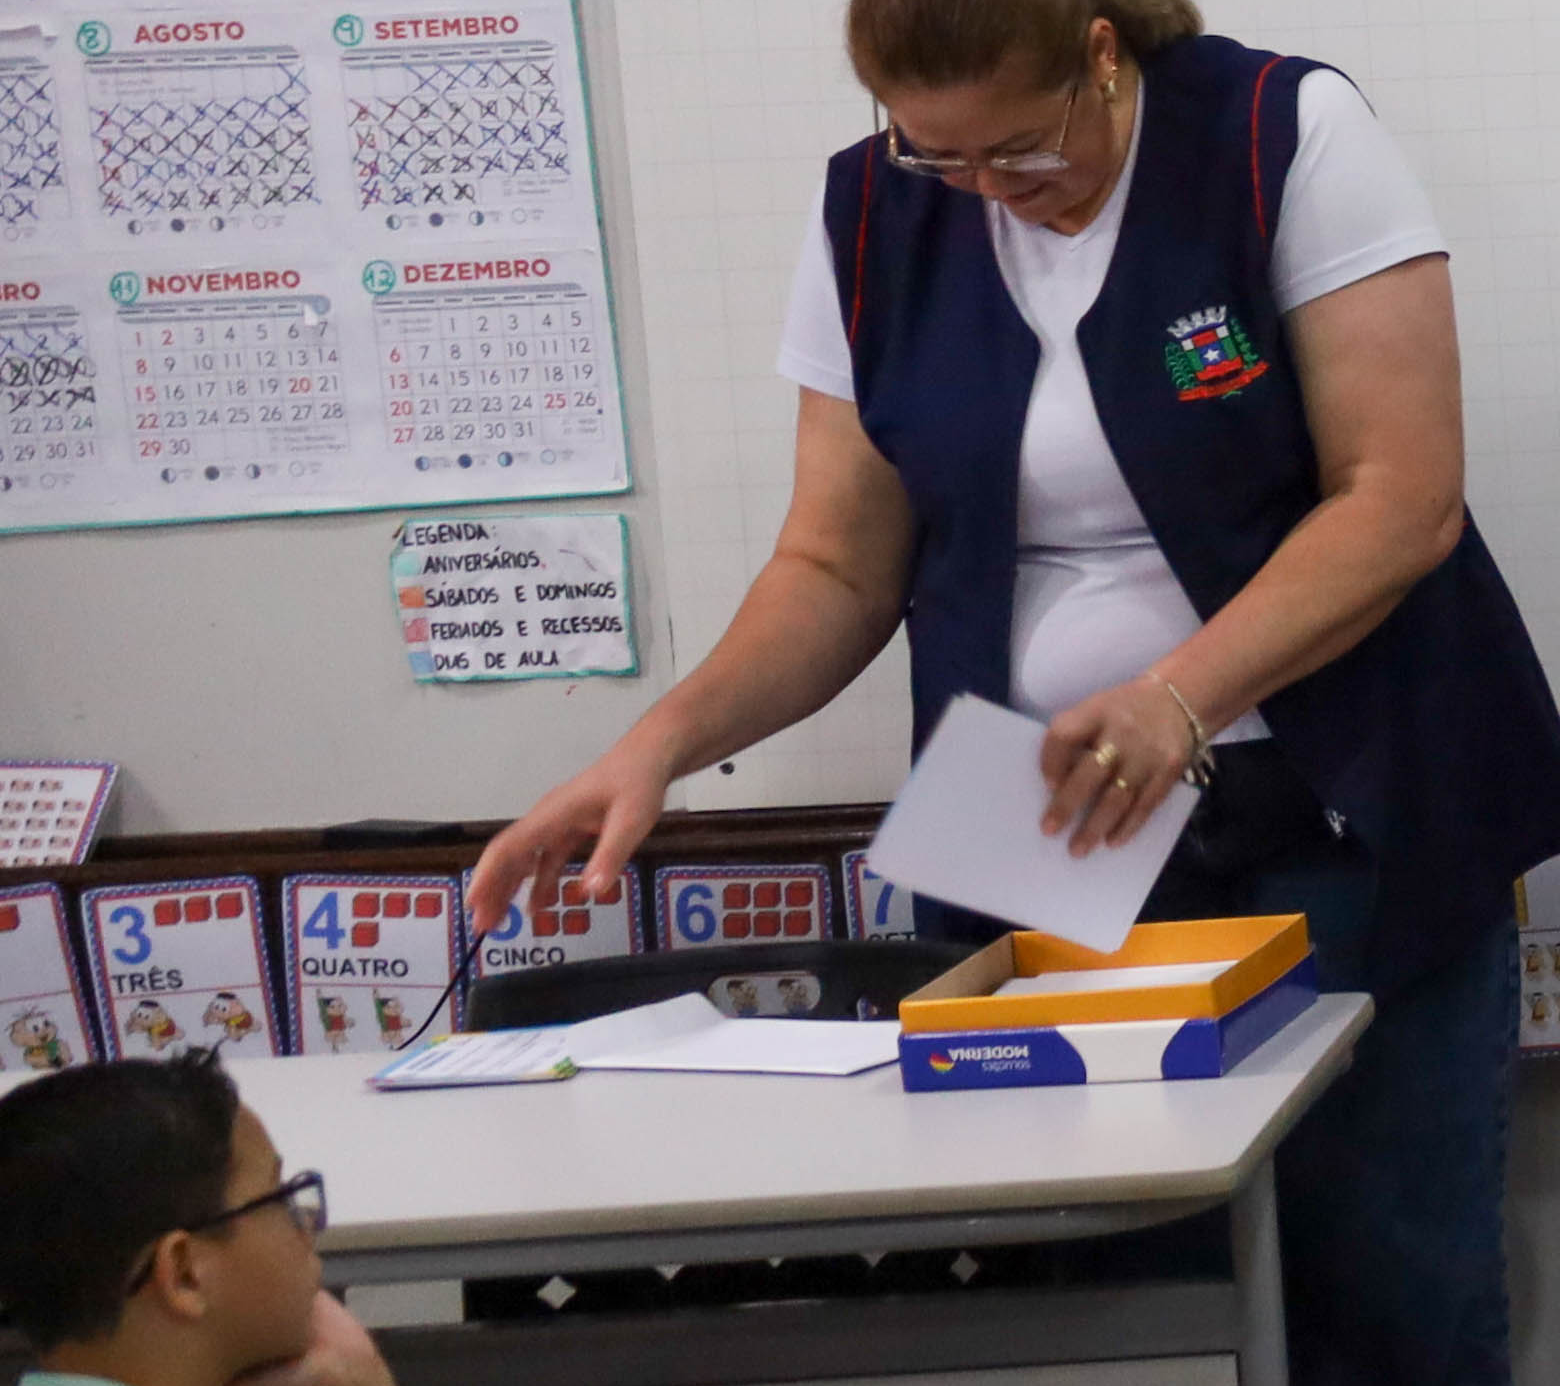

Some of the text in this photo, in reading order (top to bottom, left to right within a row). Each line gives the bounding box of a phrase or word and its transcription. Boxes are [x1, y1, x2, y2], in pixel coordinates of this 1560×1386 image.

[135, 21, 245, 43] AGOSTO
[375, 16, 520, 40] SETEMBRO
[147, 269, 301, 294] NOVEMBRO
[404, 258, 551, 284] DEZEMBRO
[425, 582, 616, 608] SÁBADOS E DOMINGOS
[431, 616, 623, 640] FERIADOS E RECESSOS
[485, 653, 506, 669] DE
[518, 650, 559, 667] AULA
[303, 892, 346, 949] 4
[673, 885, 718, 943] 6
[109, 905, 152, 965] 3
[302, 955, 410, 979] QUATRO
[486, 945, 565, 968] CINCO
[111, 963, 184, 994] TRÊS
[947, 1045, 1028, 1061] MODERNA
